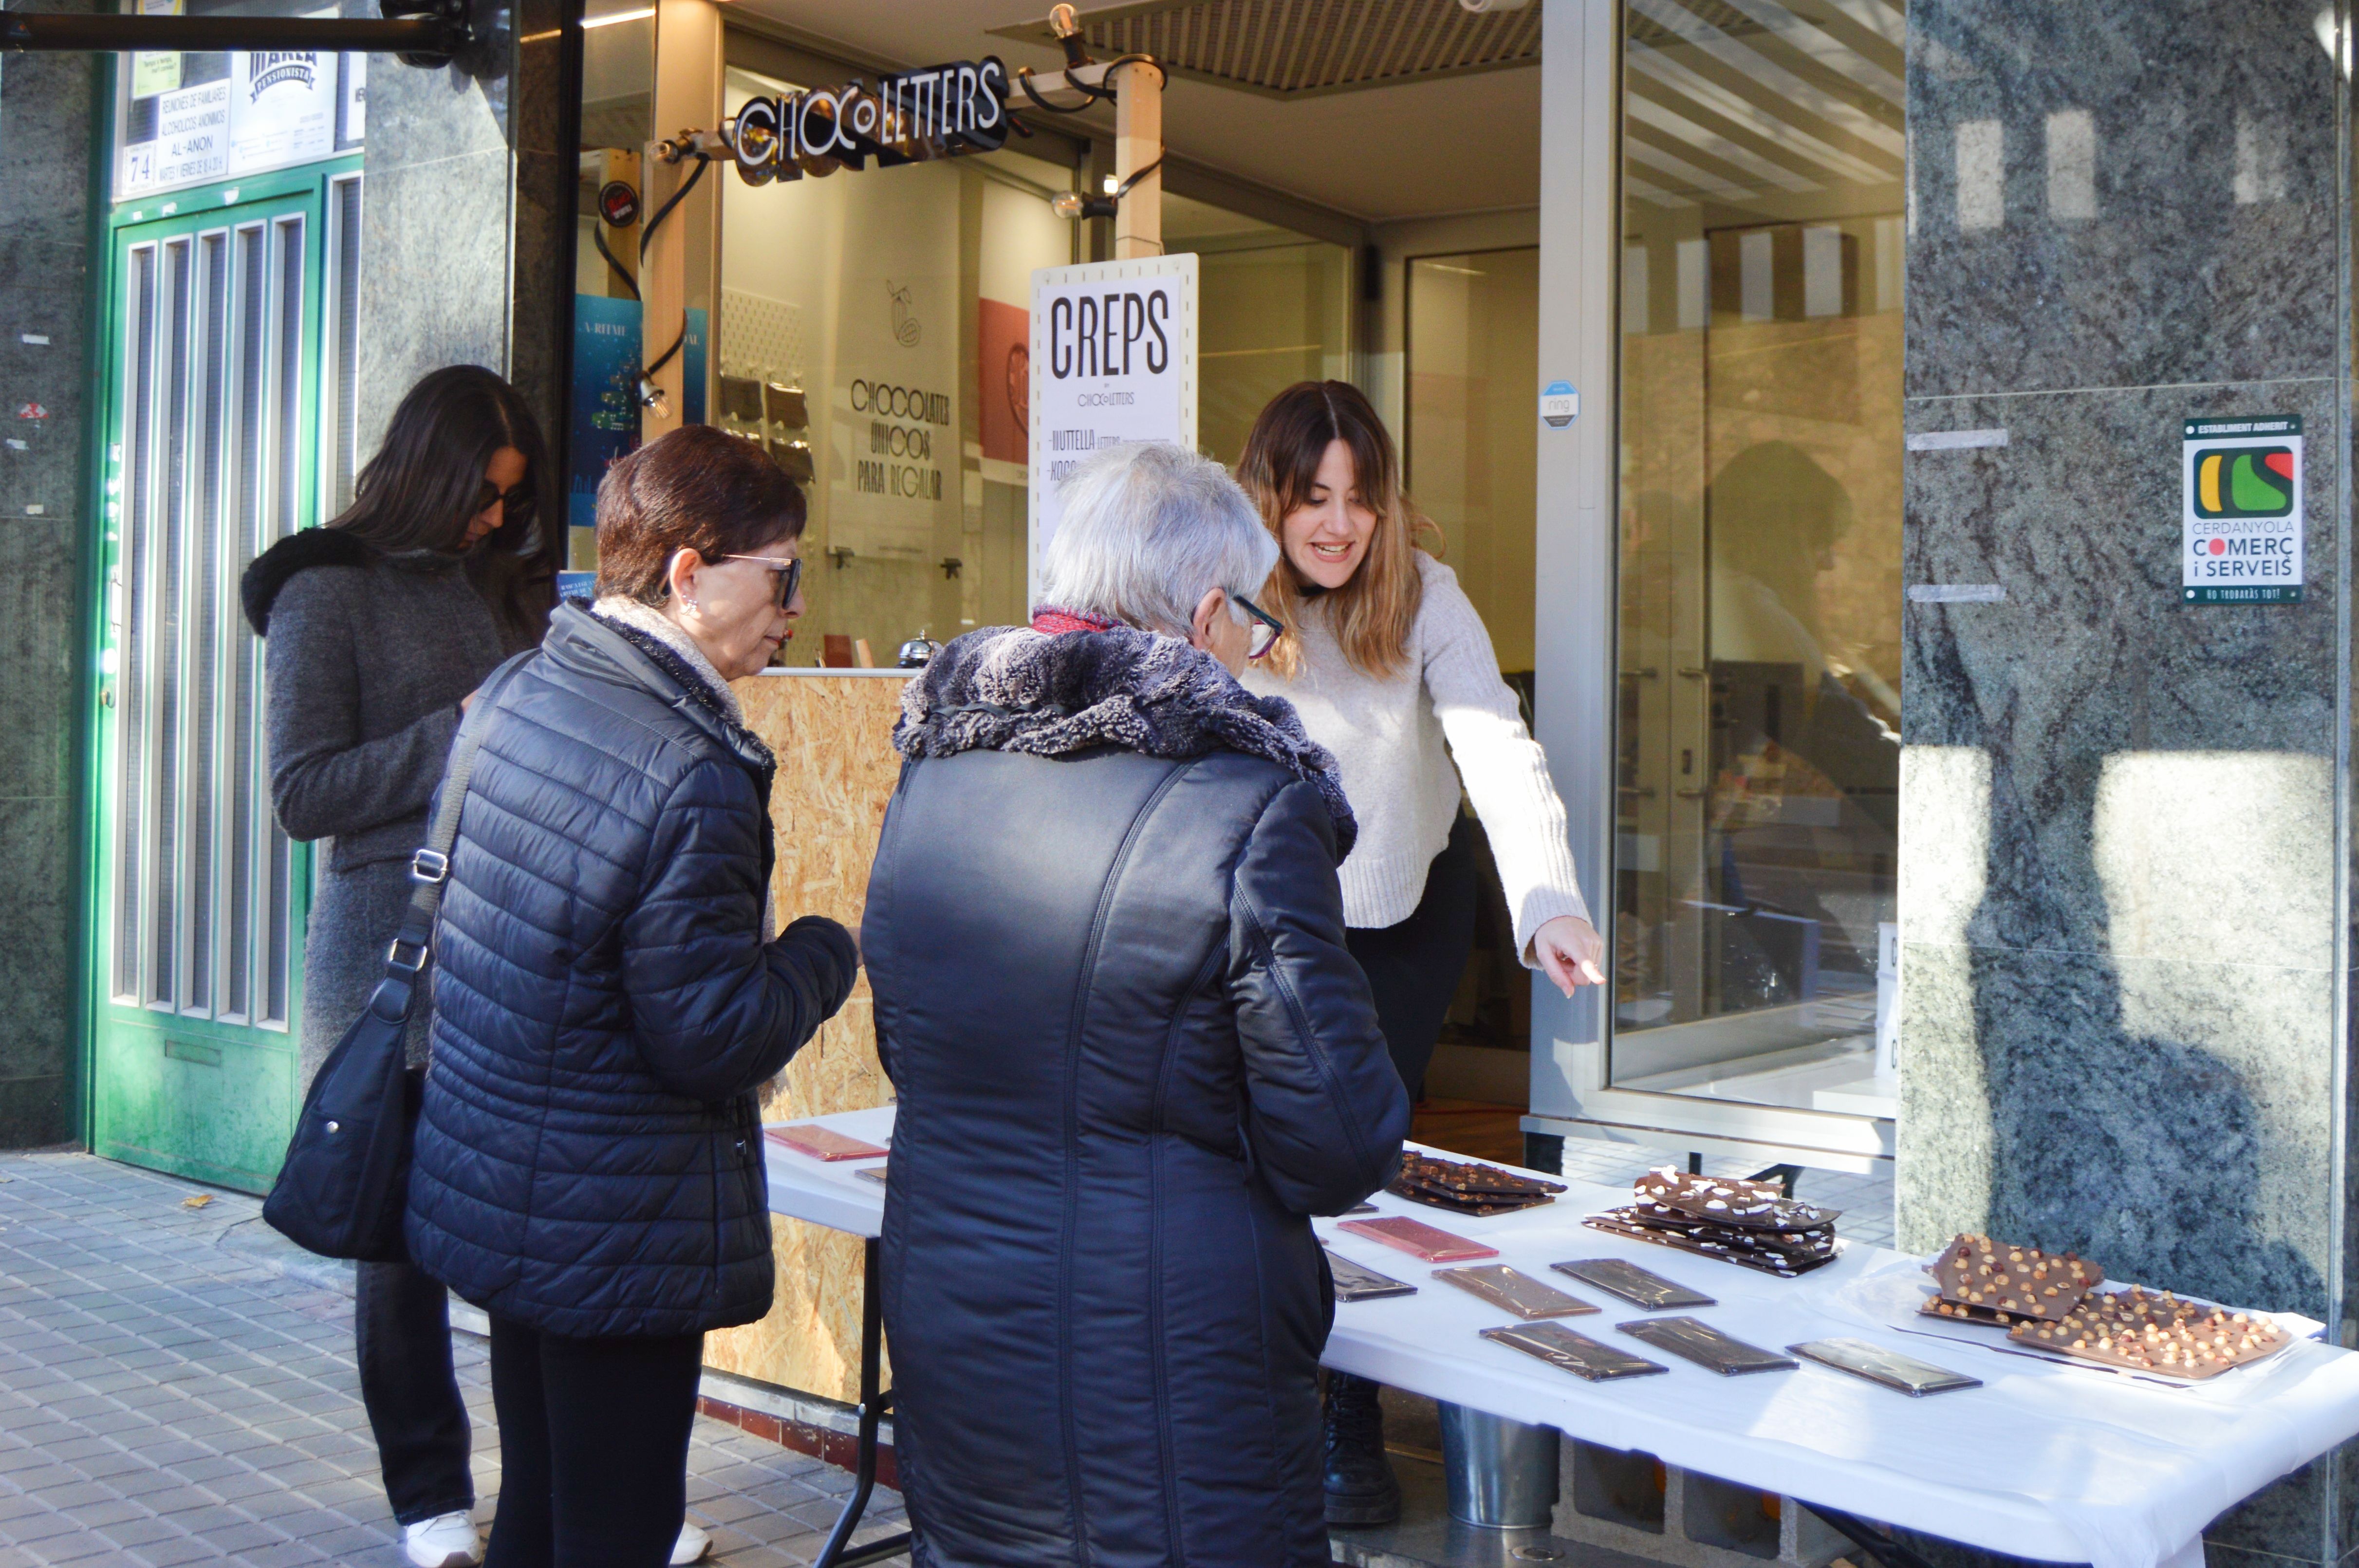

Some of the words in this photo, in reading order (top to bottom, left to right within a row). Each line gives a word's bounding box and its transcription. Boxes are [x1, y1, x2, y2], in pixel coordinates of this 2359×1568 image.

[257, 67, 309, 92] PENSIONISTA
[190, 93, 197, 108] DE
[198, 86, 226, 106] FAMILIARES
[171, 135, 213, 157] AL-ANON
[131, 154, 149, 182] 74
[1051, 290, 1169, 379] CREPS
[852, 379, 949, 426] CHOCOLATES
[1549, 398, 1570, 412] ring
[2198, 423, 2252, 434] ESTABLIMENT
[2252, 421, 2288, 432] ADHERIT
[858, 460, 885, 494] PARA
[891, 464, 942, 501] REGALAR
[2192, 521, 2294, 535] CERDANYOLA
[2193, 537, 2294, 559] COMERÇ
[2194, 561, 2198, 577] i
[2206, 559, 2292, 577] SERVEIS
[2220, 588, 2259, 599] TROBARÀS
[2262, 588, 2280, 599] TOT!
